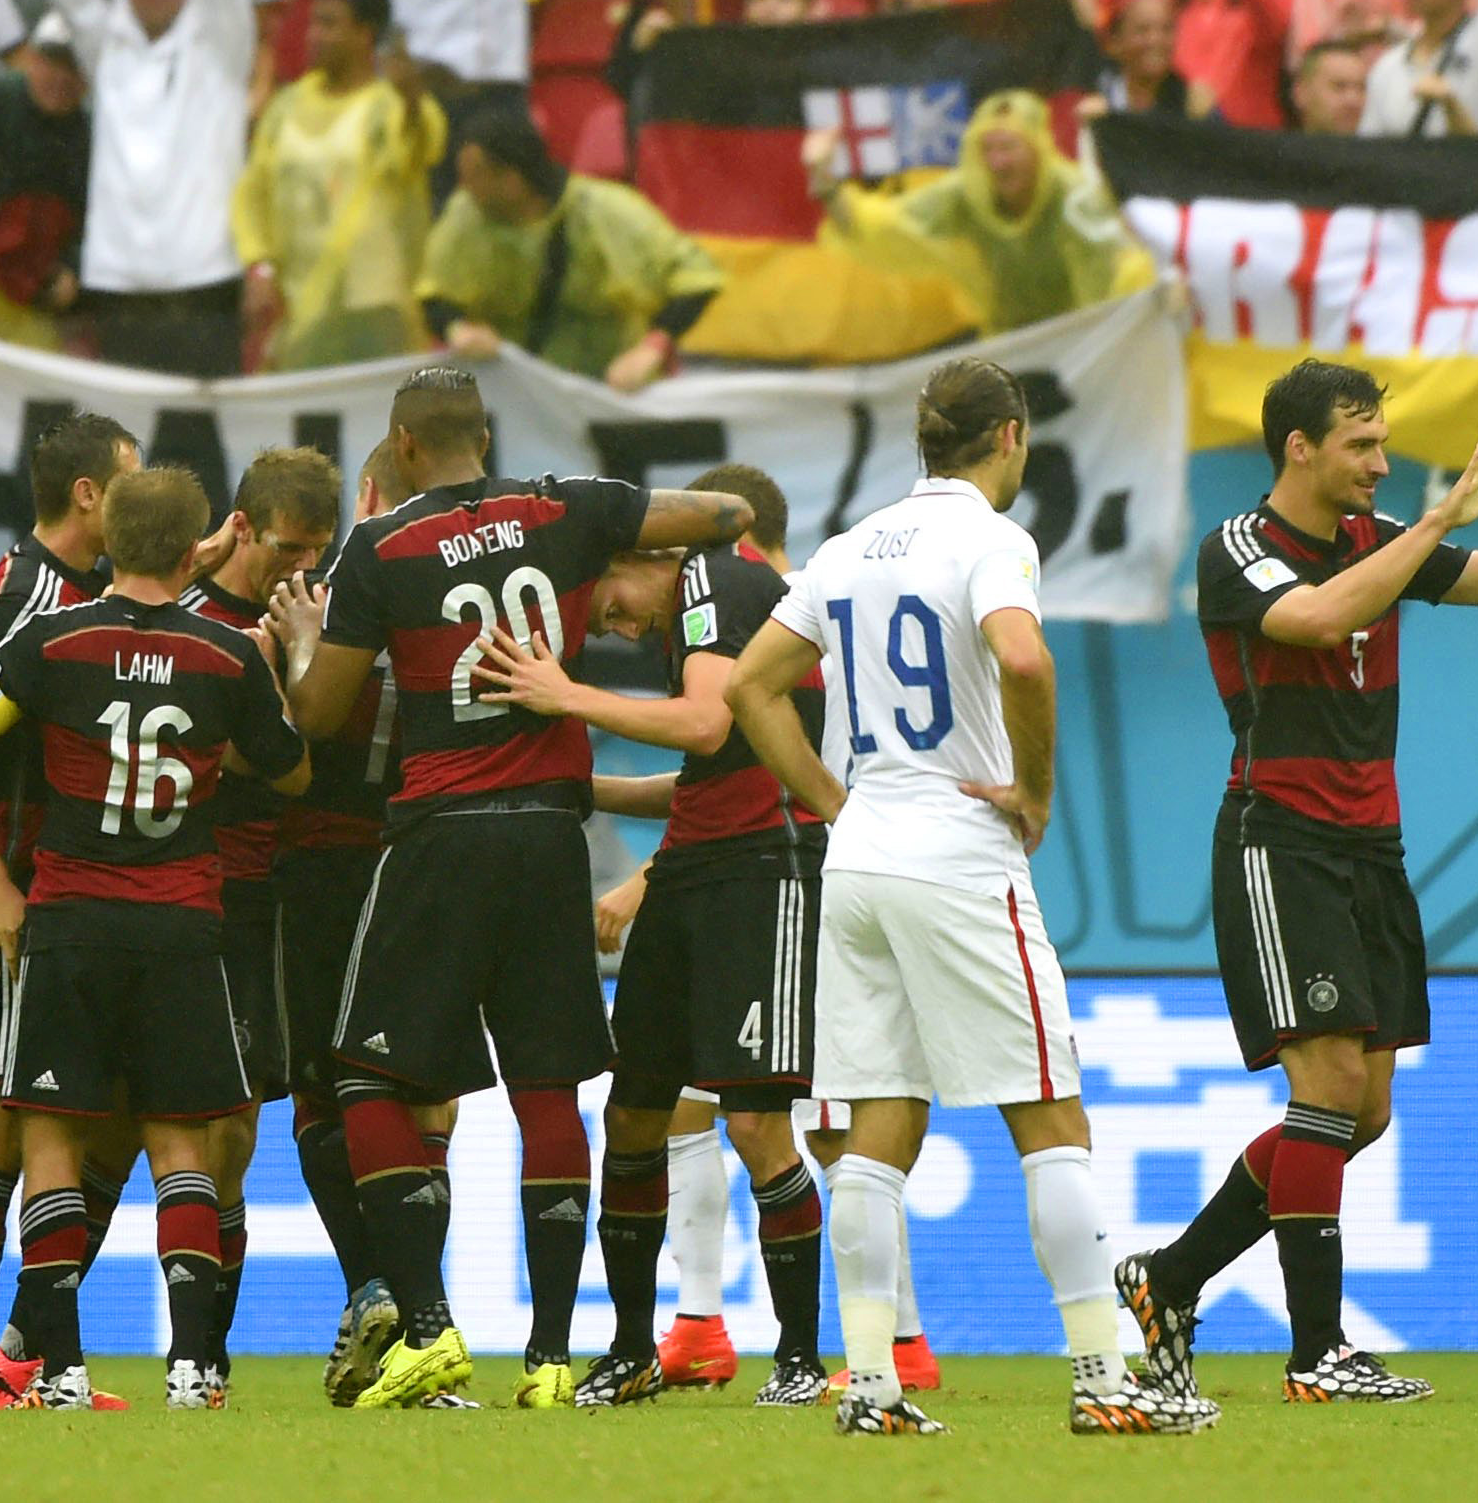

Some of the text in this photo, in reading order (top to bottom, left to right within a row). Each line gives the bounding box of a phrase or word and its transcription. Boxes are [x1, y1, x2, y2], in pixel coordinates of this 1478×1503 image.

[438, 520, 525, 569] BOATENG
[863, 527, 920, 560] ZUSI
[114, 650, 174, 686] LAHM
[441, 565, 564, 723] 20
[1349, 631, 1370, 689] 5
[826, 594, 954, 755] 19
[96, 700, 194, 840] 16
[737, 1000, 764, 1060] 4
